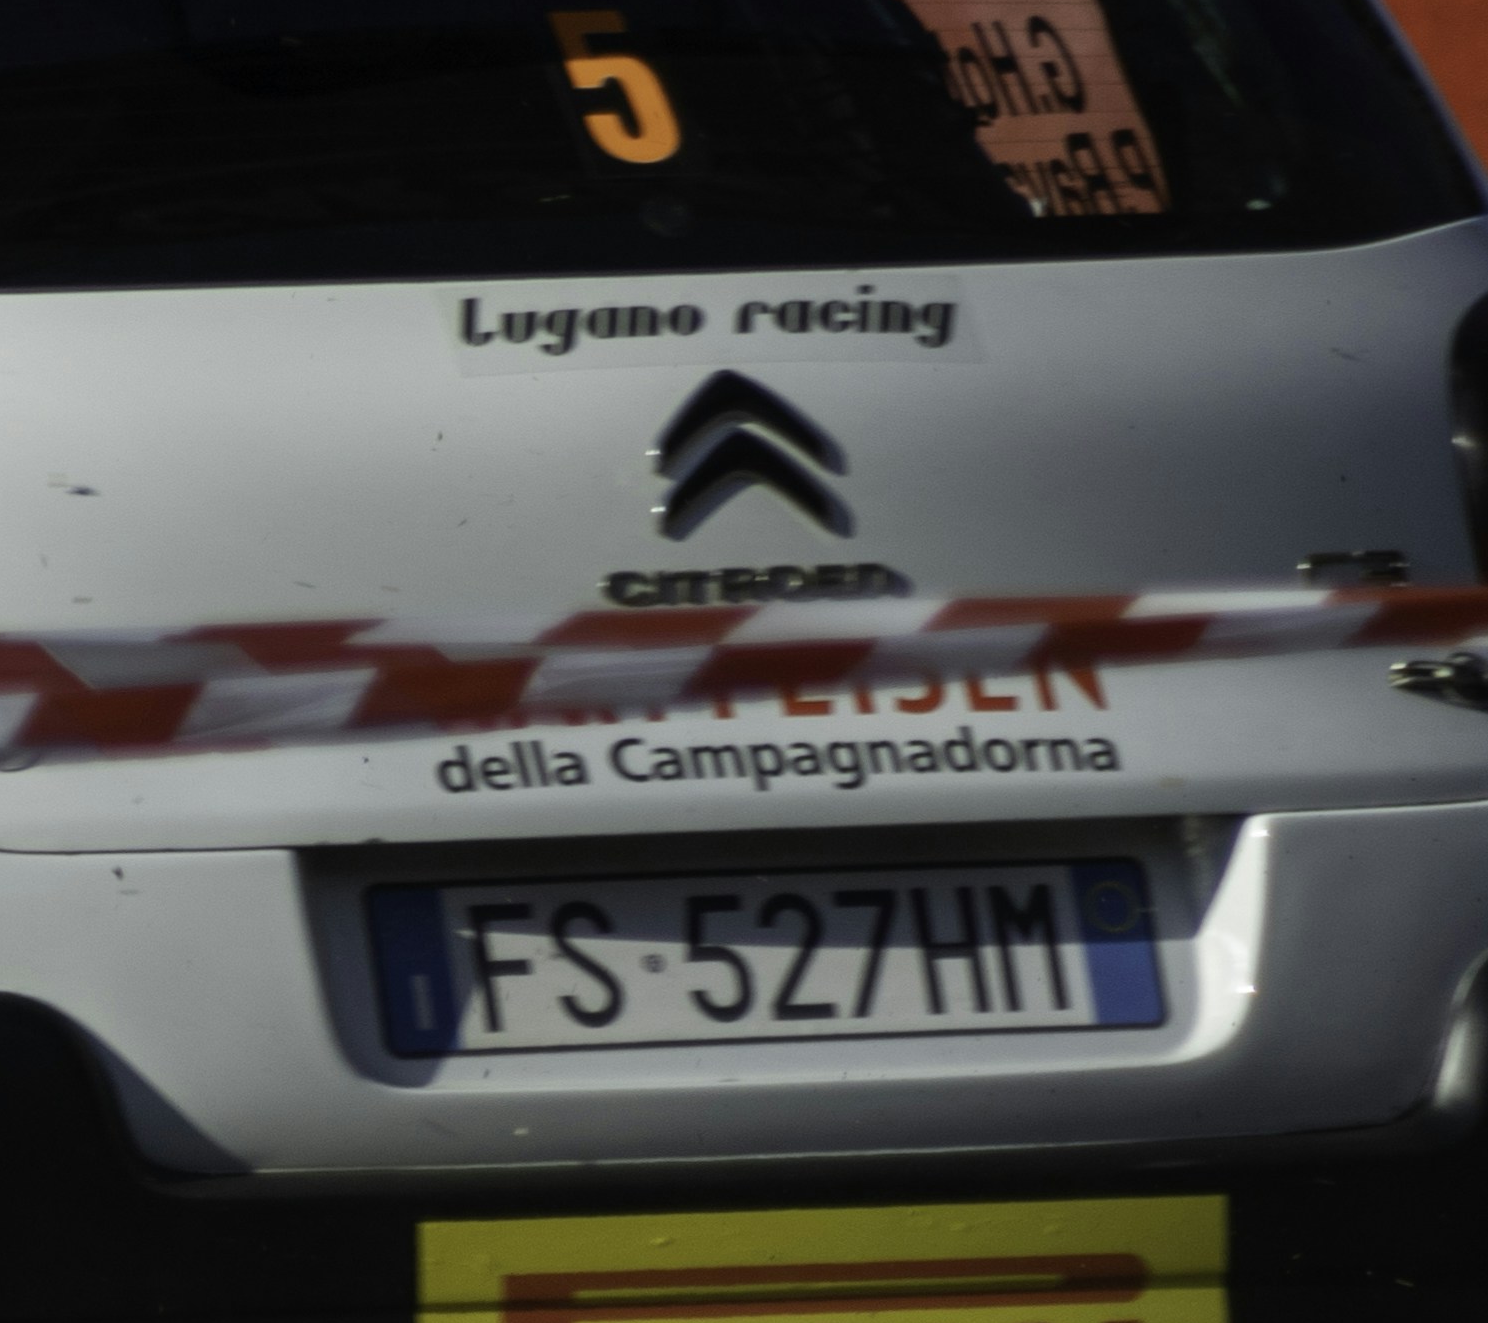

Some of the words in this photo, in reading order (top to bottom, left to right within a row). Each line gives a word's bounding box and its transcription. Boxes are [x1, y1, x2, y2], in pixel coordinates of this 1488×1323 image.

[550, 10, 681, 164] 5
[460, 297, 707, 356] Lugano
[733, 284, 958, 349] racing
[435, 740, 591, 794] della
[608, 726, 1122, 792] Campagnadorna
[467, 898, 626, 1034] FS
[683, 884, 1071, 1023] 527HM
